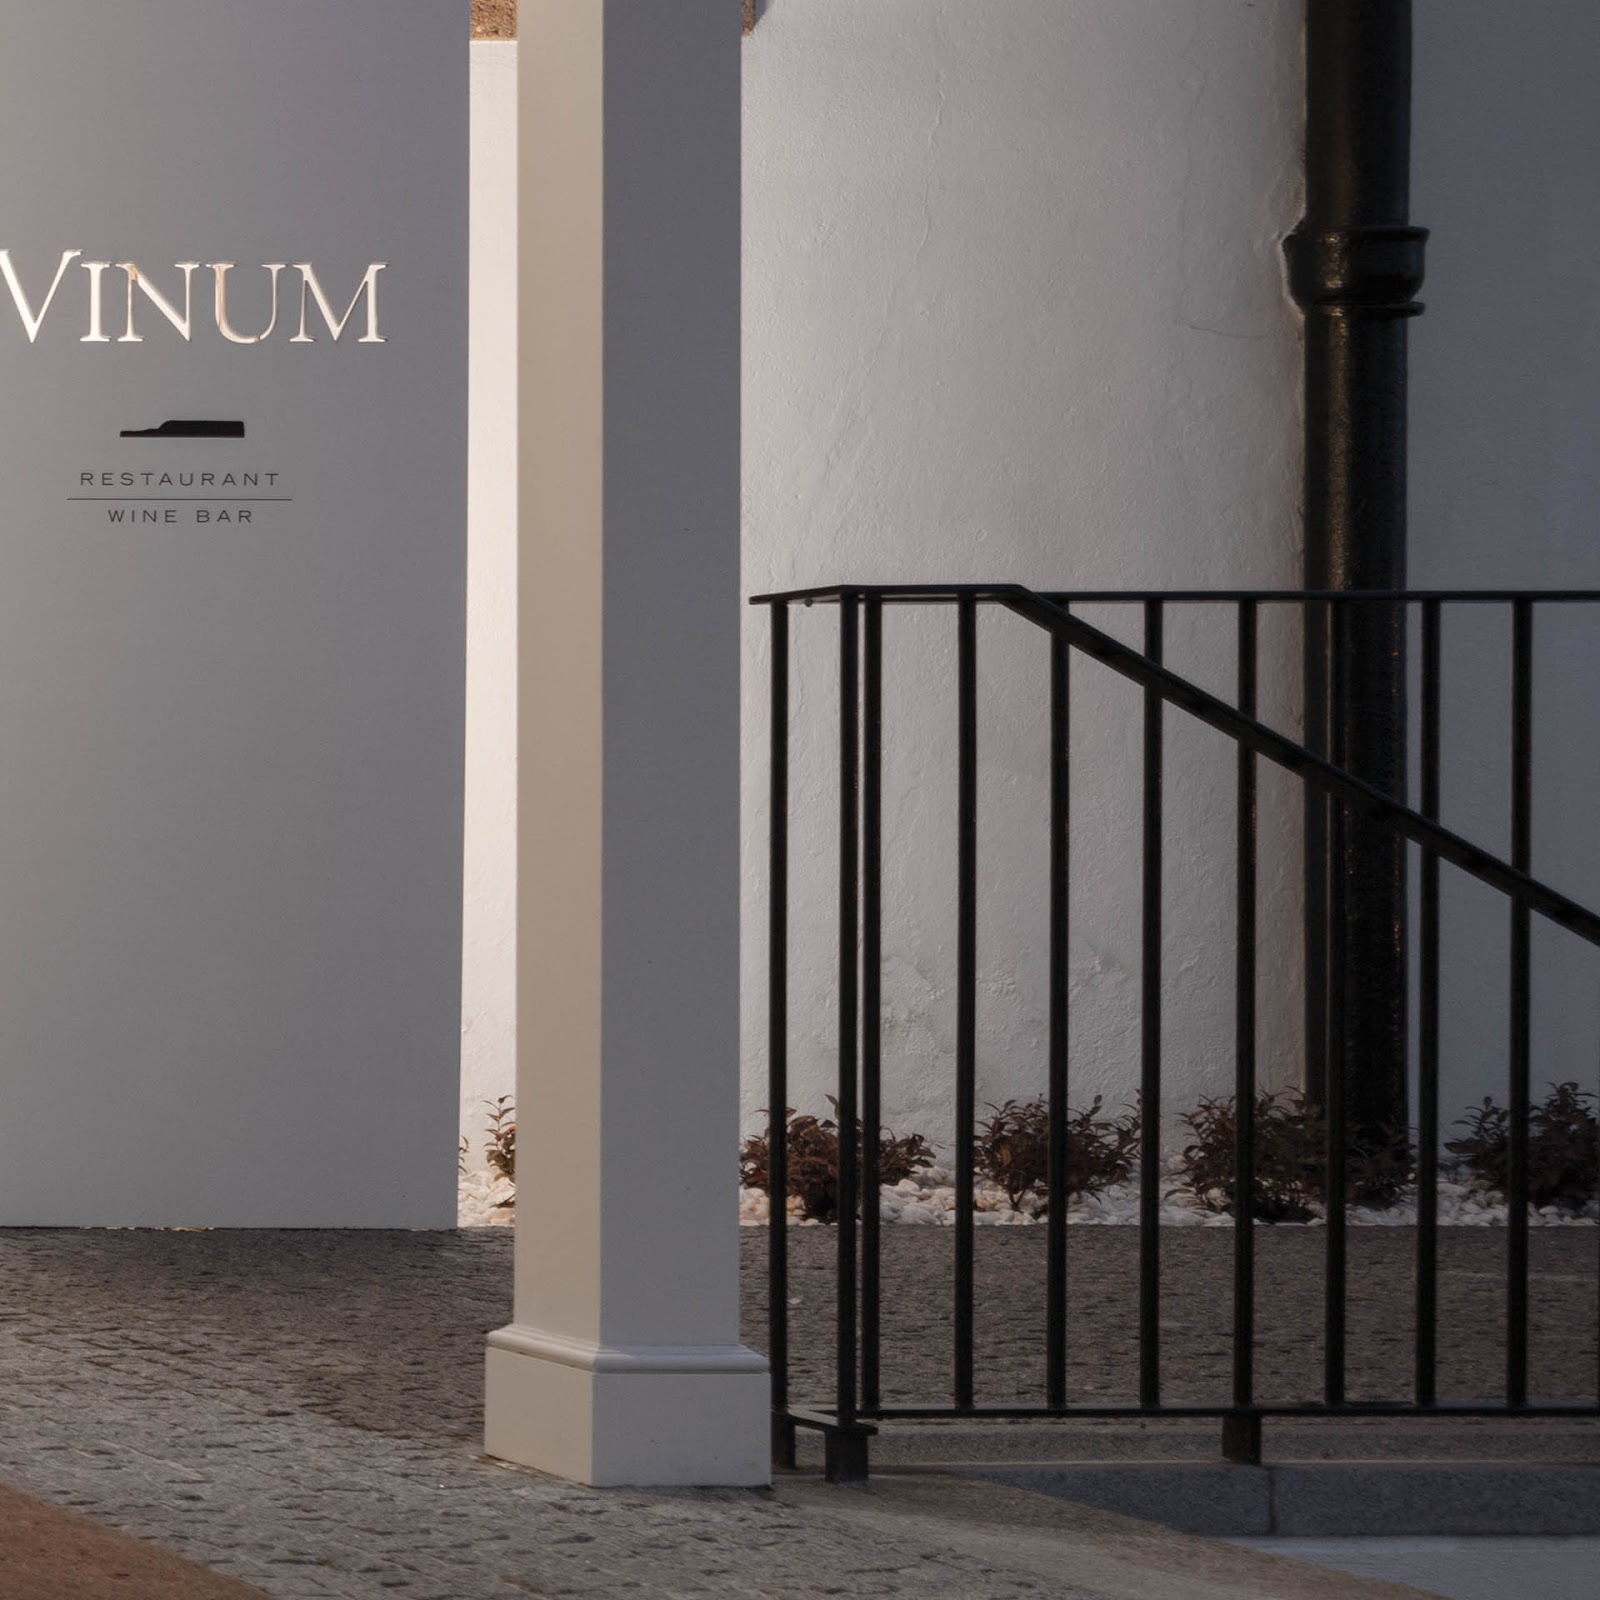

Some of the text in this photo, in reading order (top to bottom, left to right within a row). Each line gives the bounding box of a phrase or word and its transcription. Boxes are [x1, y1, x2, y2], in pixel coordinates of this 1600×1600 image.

[80, 472, 280, 487] RESTAURANT
[107, 509, 254, 523] WINE BAR
